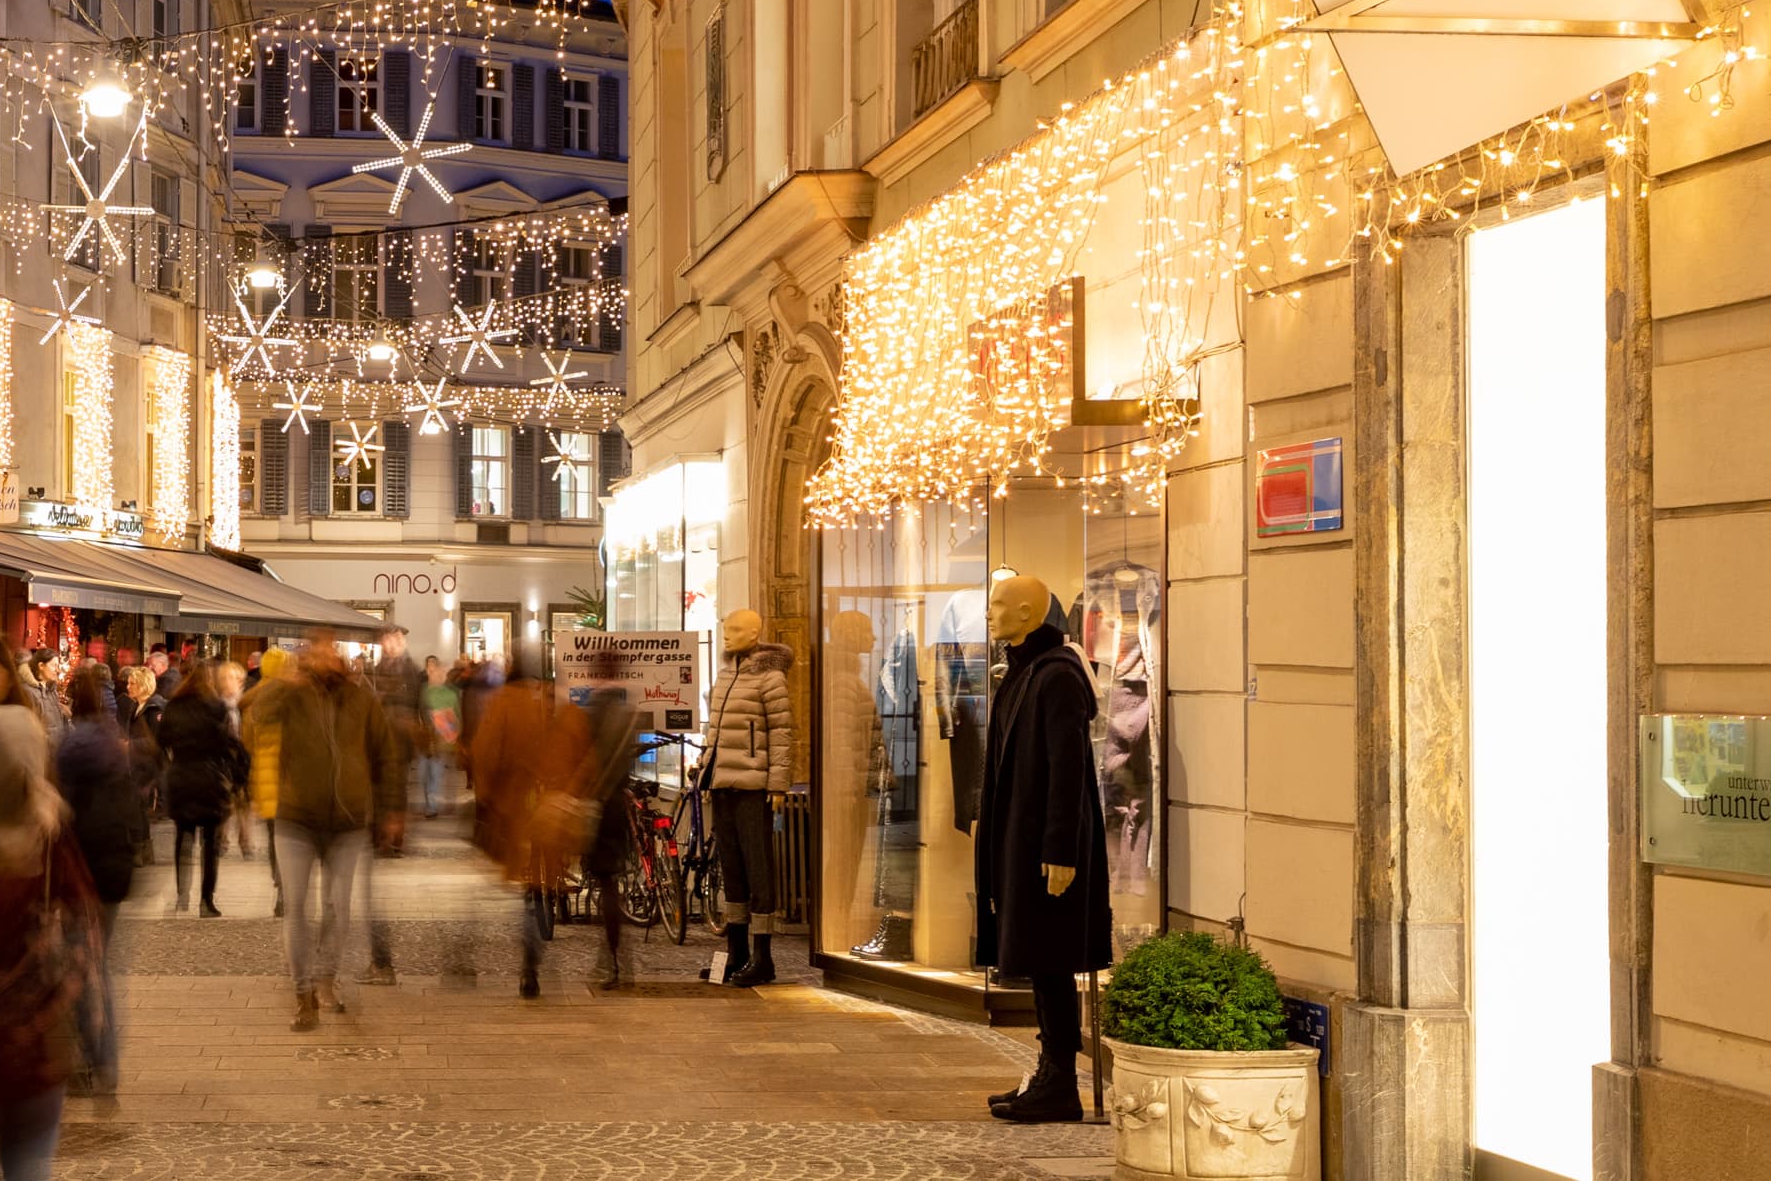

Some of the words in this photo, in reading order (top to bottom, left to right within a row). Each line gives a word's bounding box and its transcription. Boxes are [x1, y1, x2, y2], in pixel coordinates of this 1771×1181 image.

[373, 565, 457, 595] nino.d
[574, 635, 679, 650] Willkommen
[562, 652, 574, 663] in
[575, 652, 596, 663] der
[600, 652, 692, 664] Stempfergasse
[568, 671, 644, 680] FRANKOWITSCH
[1727, 774, 1771, 792] unterw
